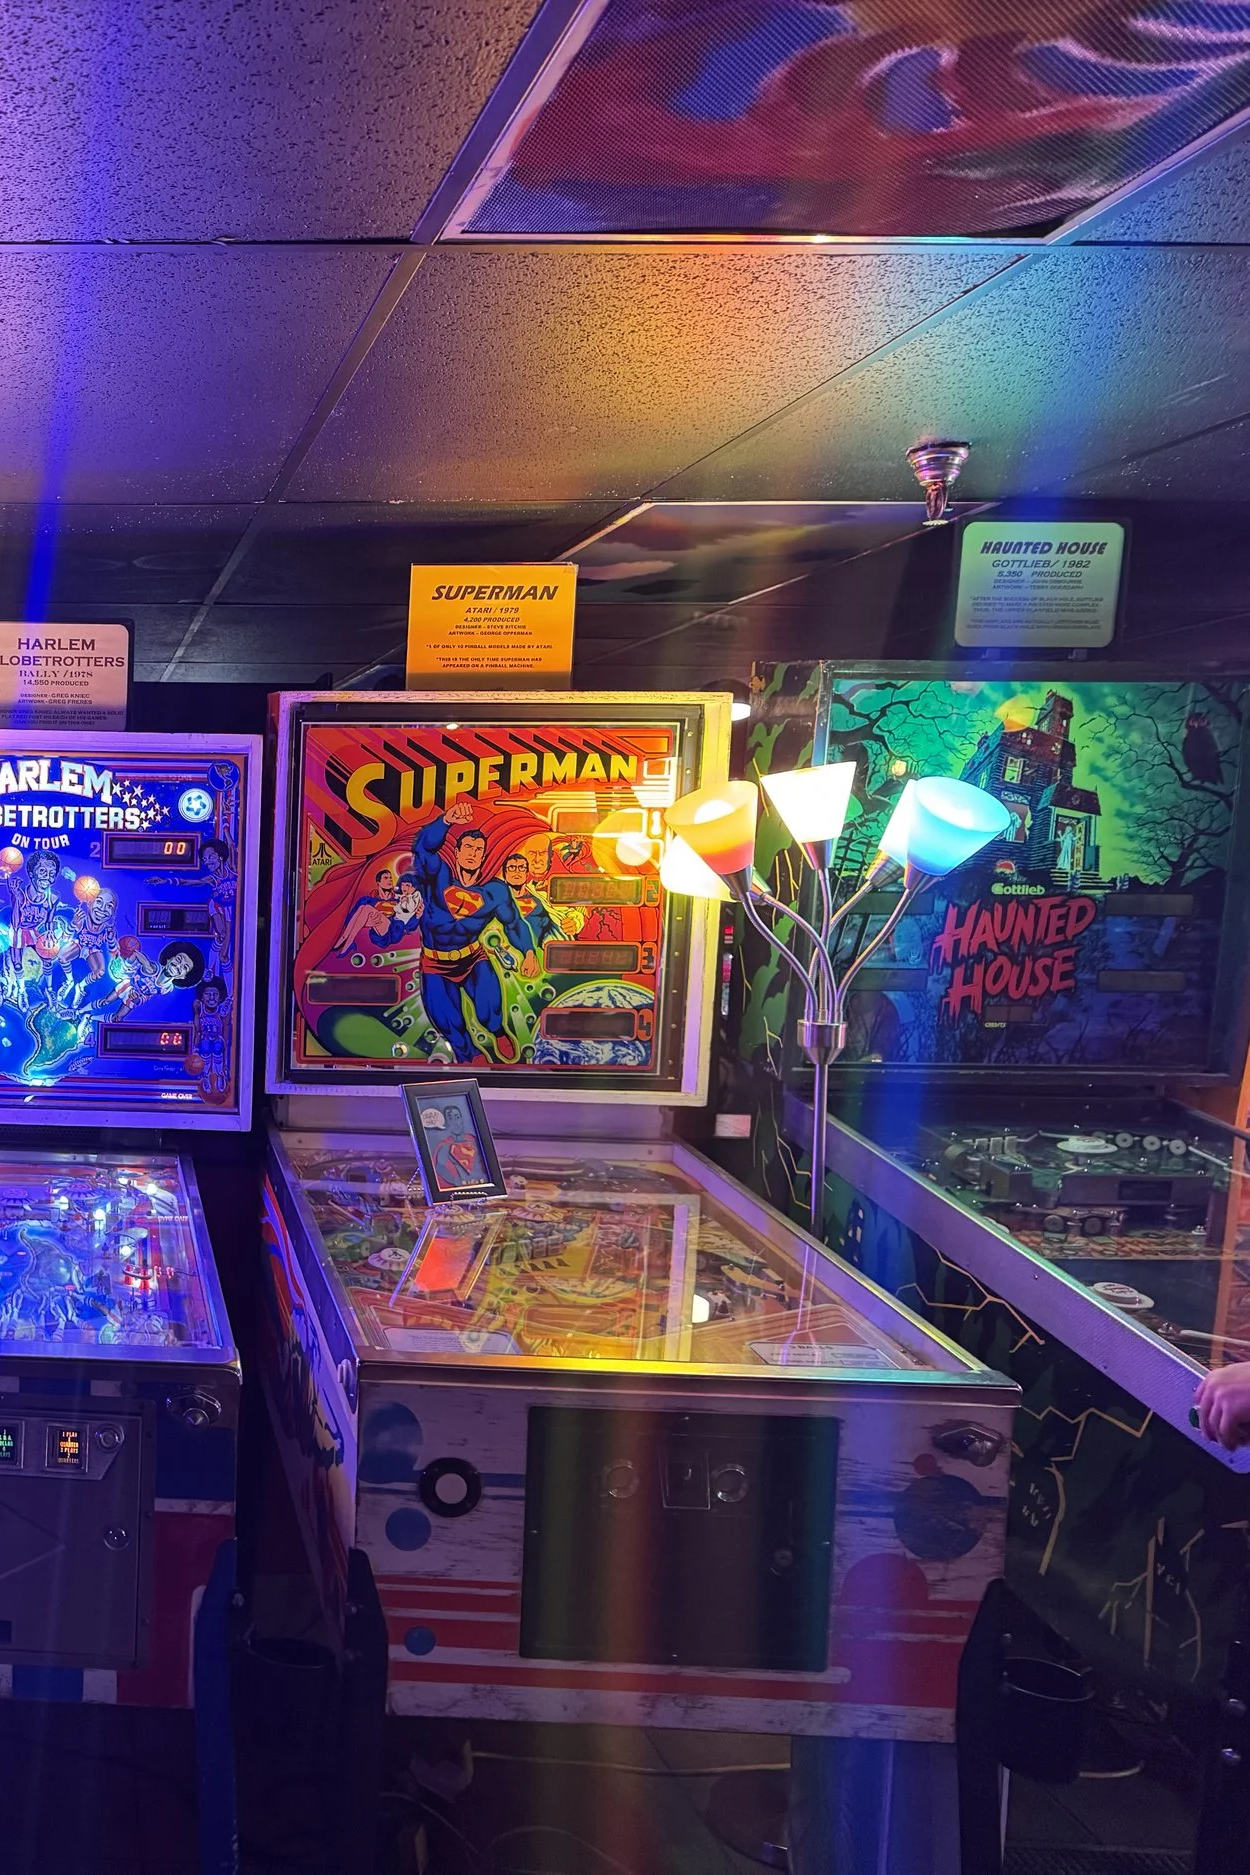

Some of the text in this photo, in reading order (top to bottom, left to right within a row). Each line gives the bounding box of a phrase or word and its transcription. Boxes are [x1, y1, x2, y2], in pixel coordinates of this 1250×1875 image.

[980, 541, 1108, 555] HAUNTED HOUSE
[1061, 560, 1091, 568] 1982
[431, 585, 559, 601] SUPERMAN
[17, 638, 96, 650] HARLEM
[19, 670, 60, 678] BALLY
[345, 752, 638, 856] SUPERMAN
[11, 833, 70, 850] ON TOUR
[89, 842, 100, 858] 2
[991, 882, 1046, 895] Gottlieb
[929, 895, 1097, 976] HAUNTED
[939, 945, 1081, 1028] HOUSE
[84, 1031, 96, 1048] 4
